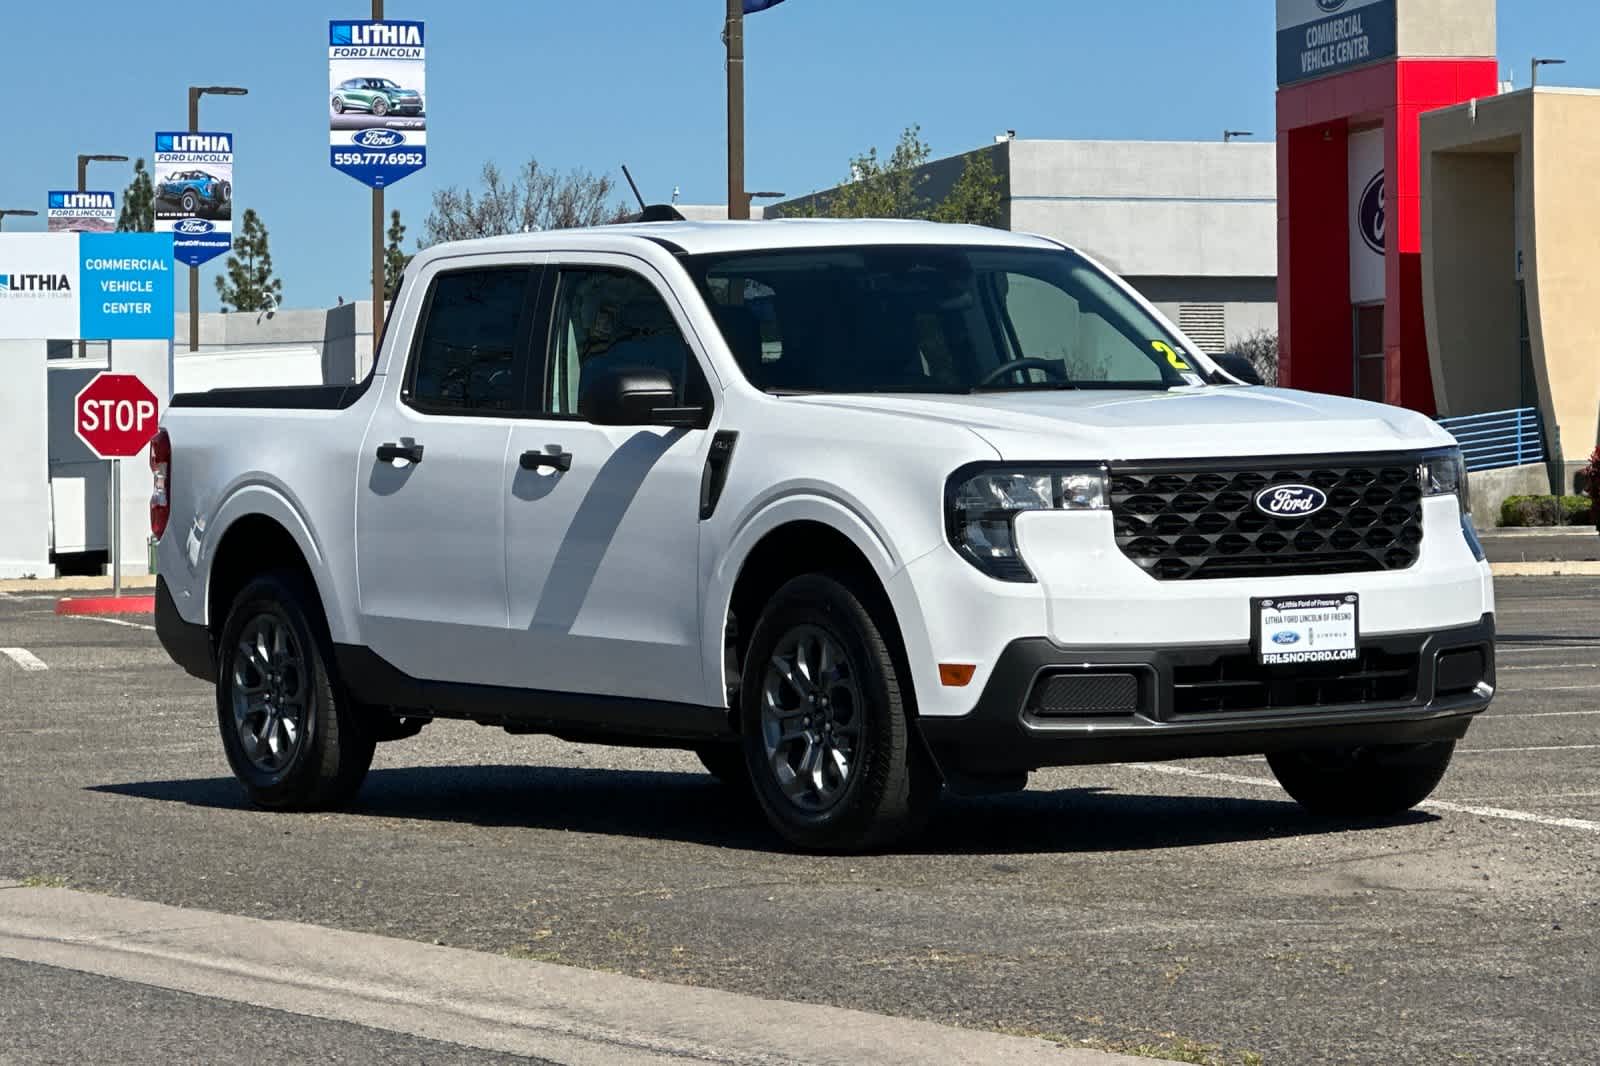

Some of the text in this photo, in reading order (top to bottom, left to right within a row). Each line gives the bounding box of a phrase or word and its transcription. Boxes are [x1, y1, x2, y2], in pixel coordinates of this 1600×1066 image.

[352, 25, 421, 45] LITHIA
[1306, 13, 1363, 49] COMMERCIAL
[333, 47, 421, 57] FORD LINCOLN
[1301, 35, 1369, 72] VEHICLE CENTER
[173, 136, 230, 152] LITHIA
[362, 130, 395, 145] Ford
[334, 153, 423, 165] 559.777.6952
[64, 194, 113, 207] LITHIA
[180, 221, 207, 233] Ford
[85, 259, 168, 271] COMMERCIAL
[9, 274, 71, 291] LITHIA
[101, 281, 153, 292] VEHICLE
[103, 303, 152, 314] CENTER
[1151, 341, 1191, 370] 2
[81, 399, 155, 432] STOP
[1270, 488, 1314, 511] Ford
[1265, 612, 1352, 624] LITHIA FORD LINCOLN OF FRESNO
[1263, 649, 1357, 664] FRESNOFORD.COM
